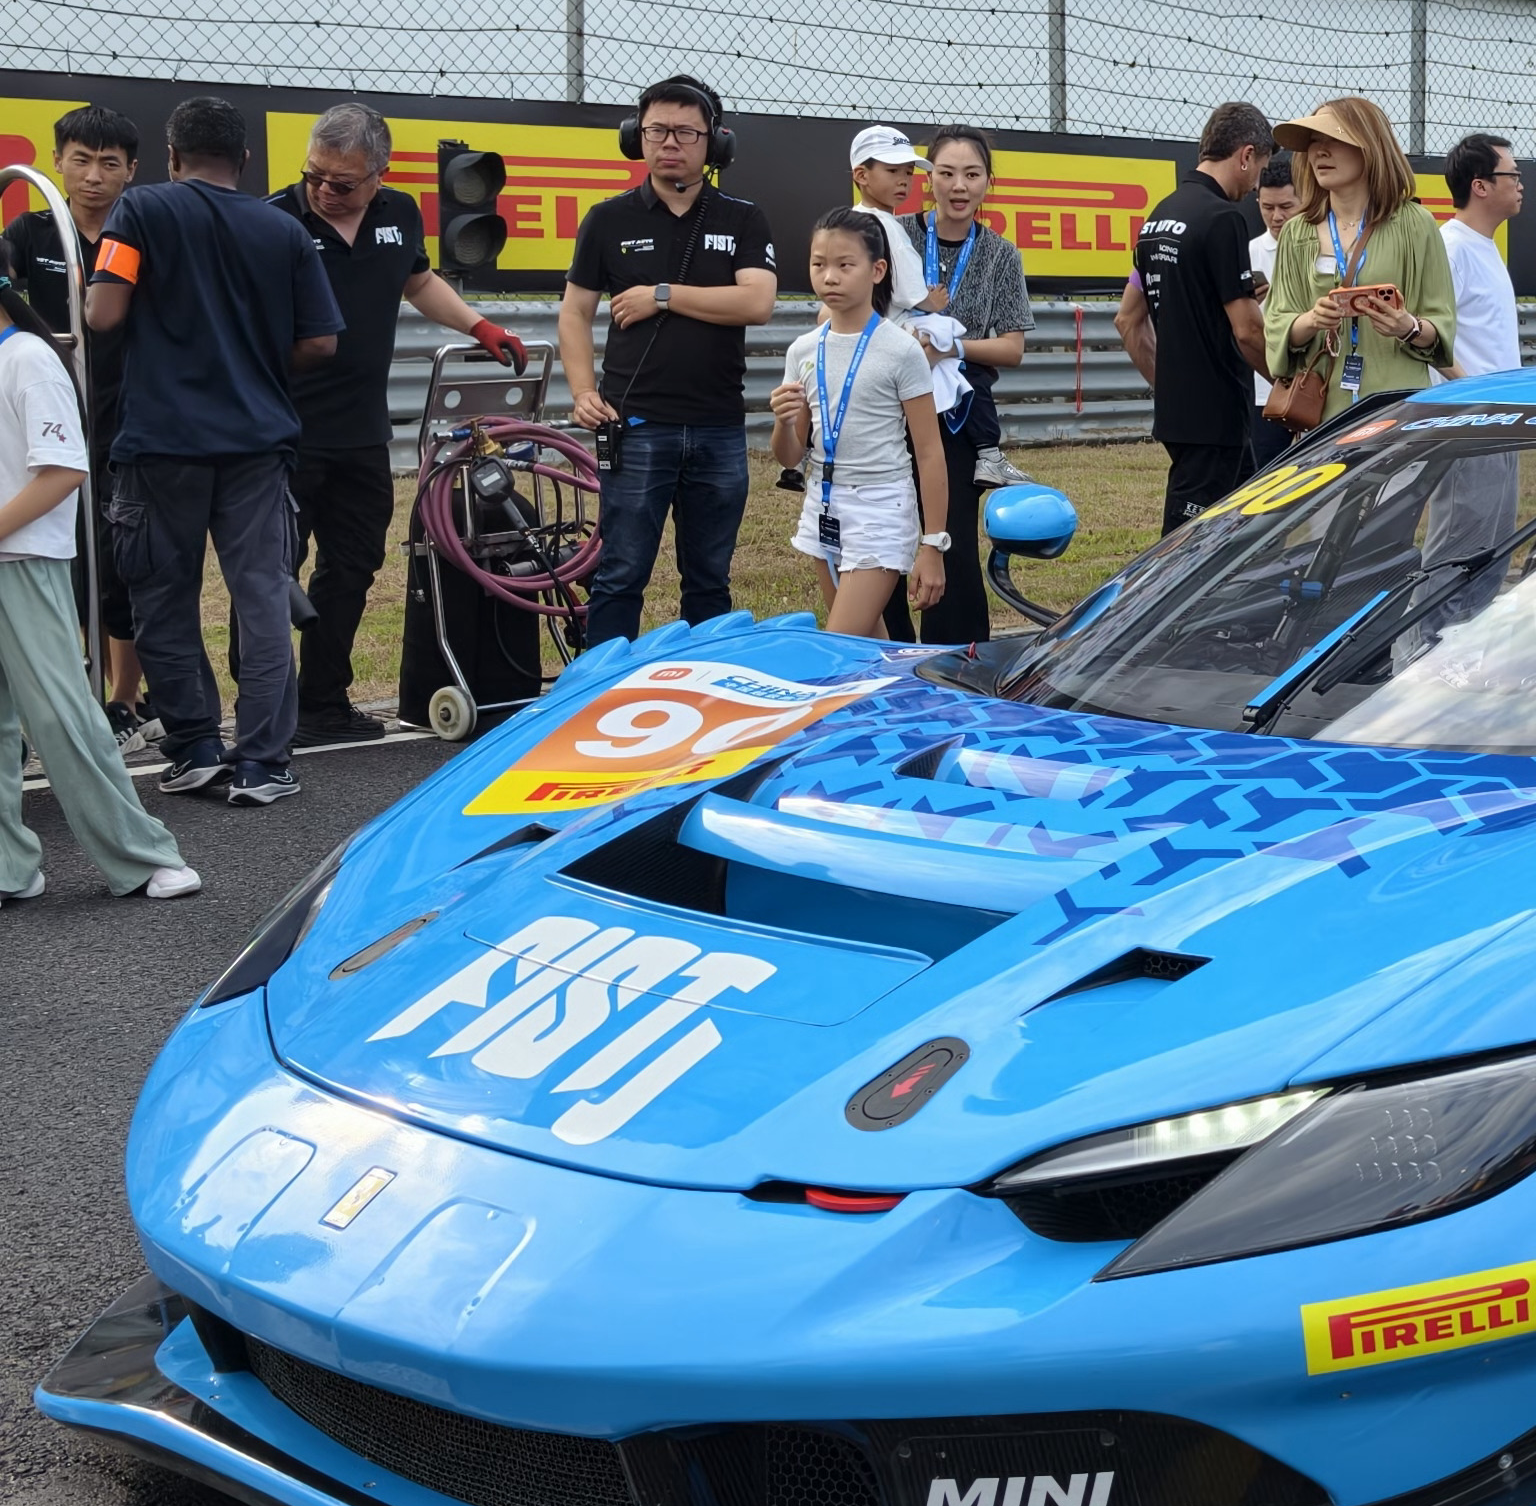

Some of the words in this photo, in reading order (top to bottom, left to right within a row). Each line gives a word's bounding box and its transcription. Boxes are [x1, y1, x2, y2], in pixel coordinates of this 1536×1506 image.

[42, 422, 62, 437] 74
[1196, 463, 1347, 521] 90
[1328, 1278, 1531, 1360] PIRELLI
